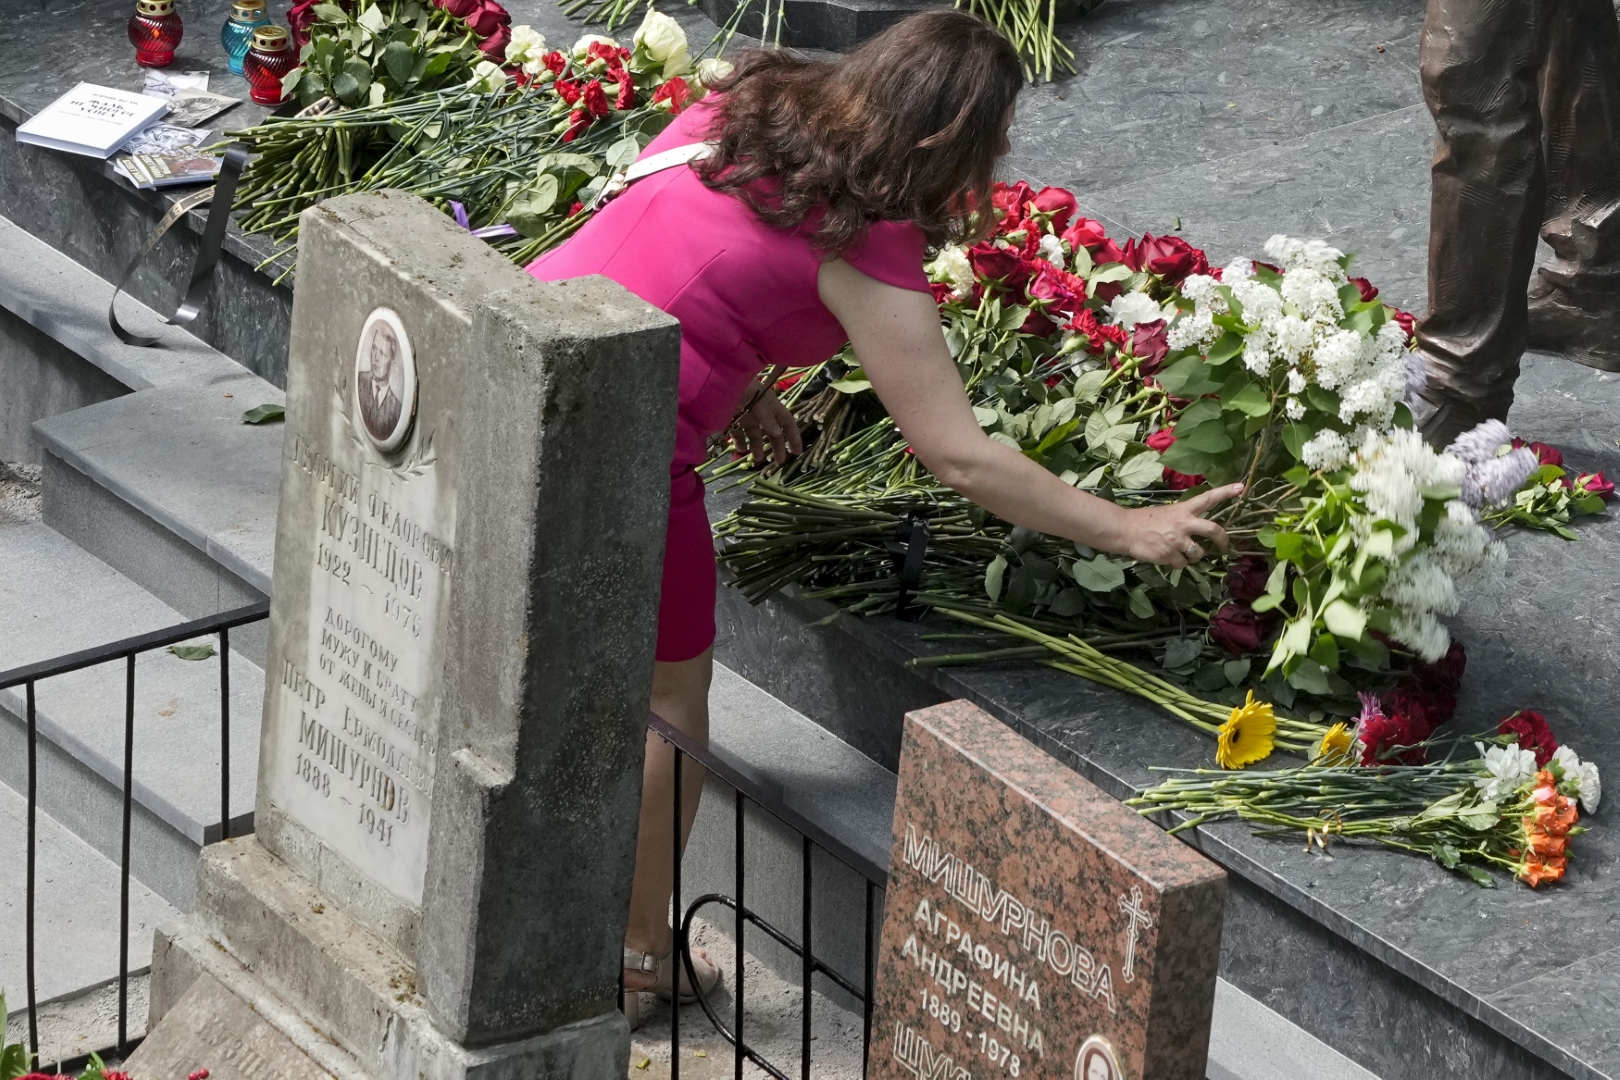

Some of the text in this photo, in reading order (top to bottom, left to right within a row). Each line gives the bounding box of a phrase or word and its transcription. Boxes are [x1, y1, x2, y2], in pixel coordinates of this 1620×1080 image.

[317, 542, 351, 587] 1922
[320, 494, 423, 601] КУЗНЕЦОВ
[282, 659, 326, 710] ПЕТР
[321, 628, 418, 713] МУЖУ И БРАТУ
[325, 606, 398, 671] ДОРОГОМУ
[319, 653, 335, 675] ОТ
[338, 670, 377, 709] ЖЕНЫ
[379, 698, 388, 718] И
[296, 753, 331, 798] 1888
[358, 803, 394, 848] 1941
[298, 710, 409, 824] МИШУРНОВ
[903, 822, 1116, 1015] МИШУРНОВА
[914, 898, 1041, 1011] АГРАФИНА
[901, 933, 1045, 1058] АНДРЕЕВНА
[919, 987, 961, 1034] 1889
[977, 1031, 1021, 1078] 1978
